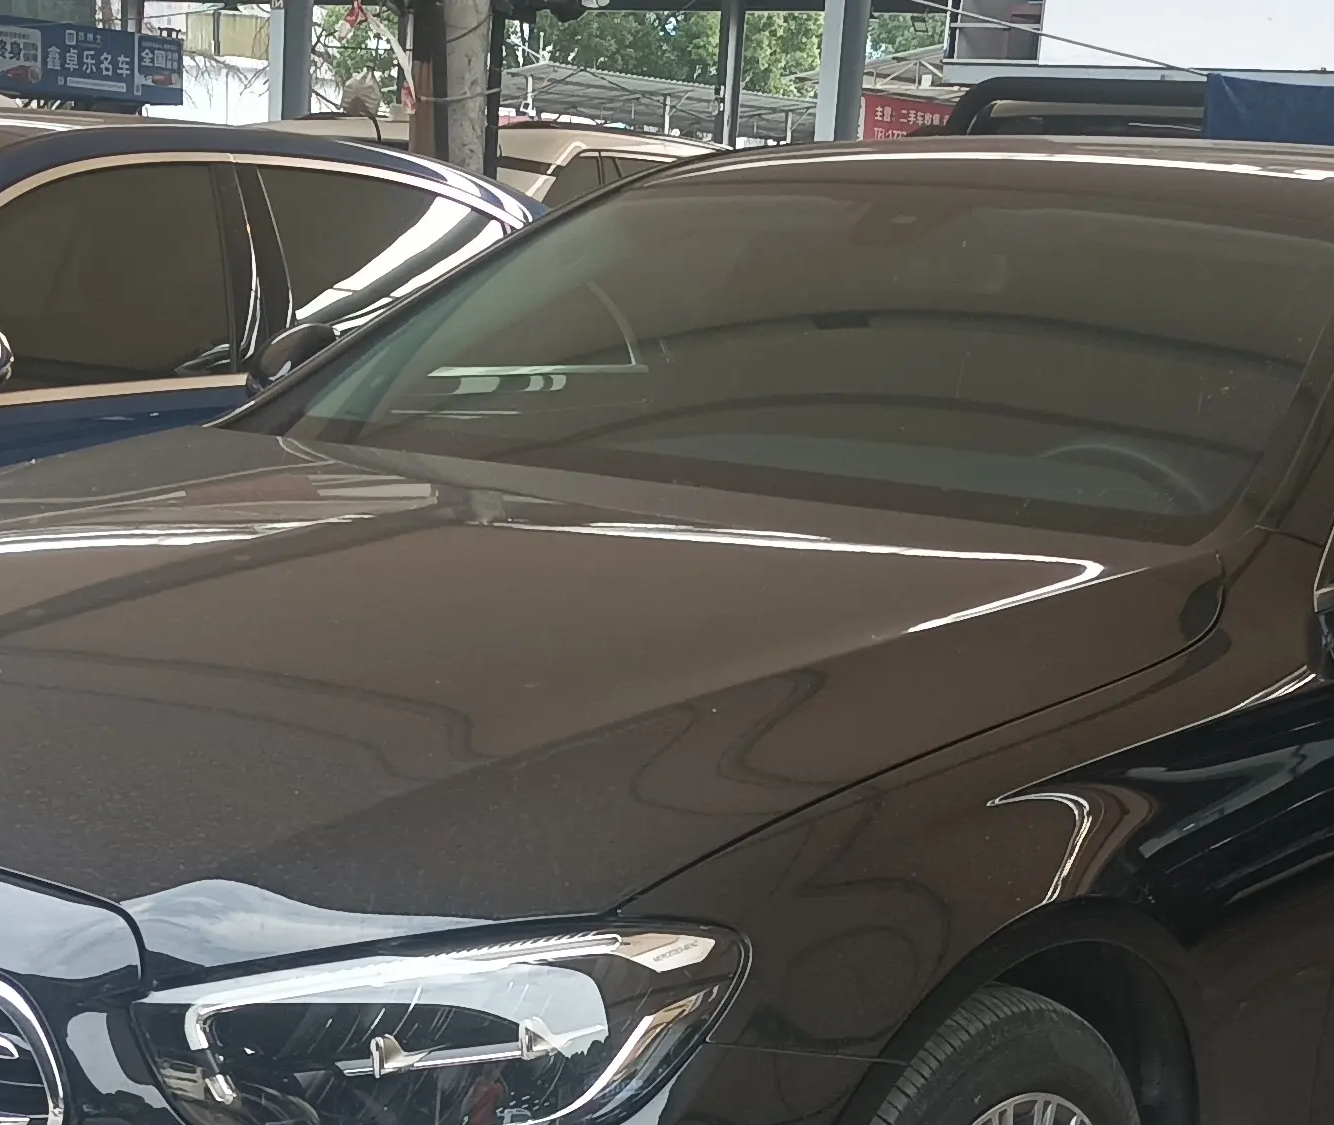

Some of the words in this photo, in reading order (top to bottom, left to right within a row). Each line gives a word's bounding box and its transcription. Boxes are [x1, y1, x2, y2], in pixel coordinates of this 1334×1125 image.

[47, 45, 131, 78] 鑫卓乐名车
